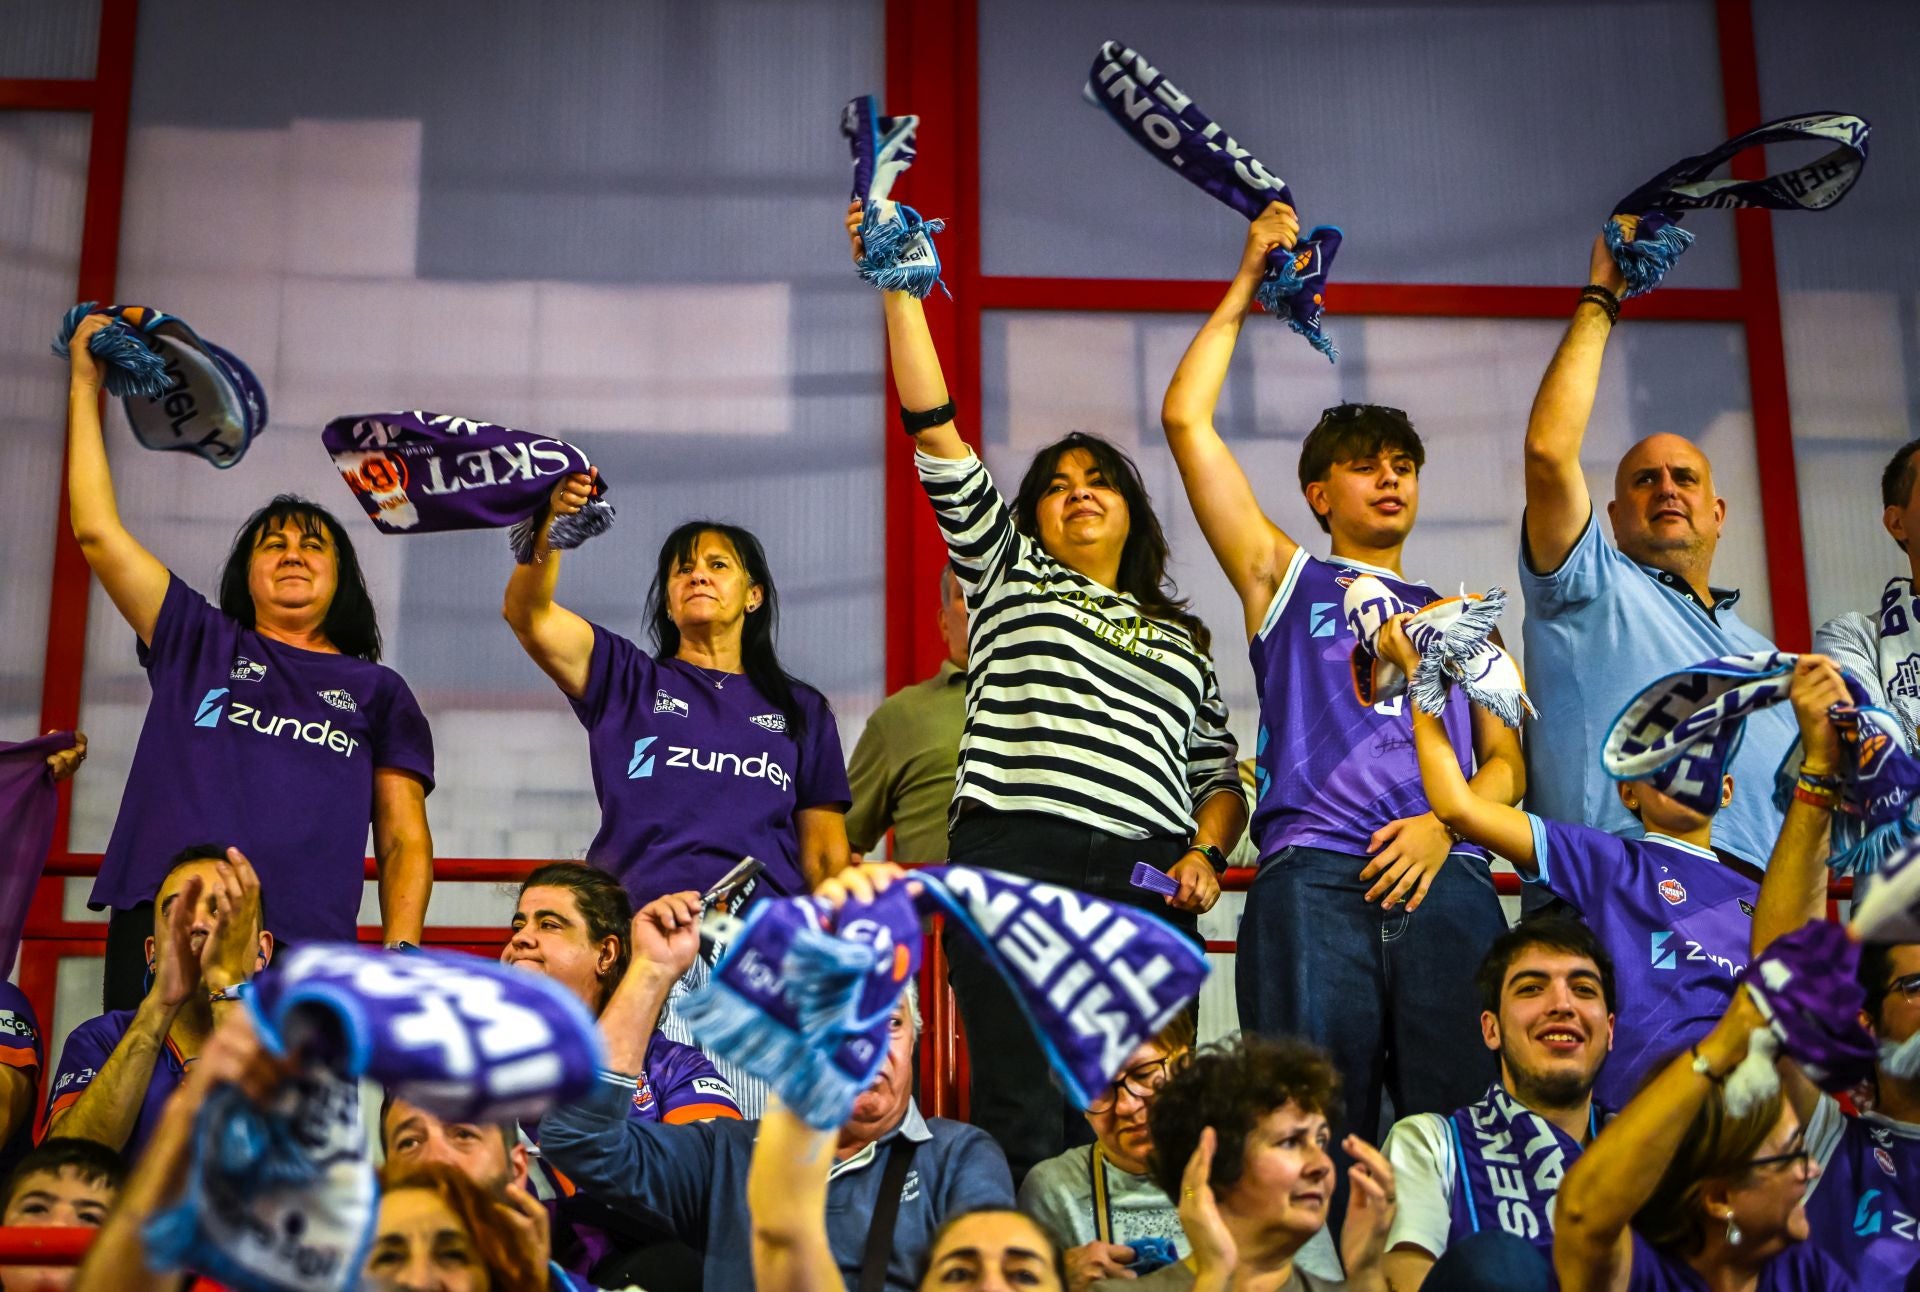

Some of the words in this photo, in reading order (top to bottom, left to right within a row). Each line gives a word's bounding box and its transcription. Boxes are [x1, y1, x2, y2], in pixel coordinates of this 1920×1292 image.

[422, 439, 590, 495] SKET
[227, 702, 359, 758] zunder
[666, 746, 791, 792] zunder
